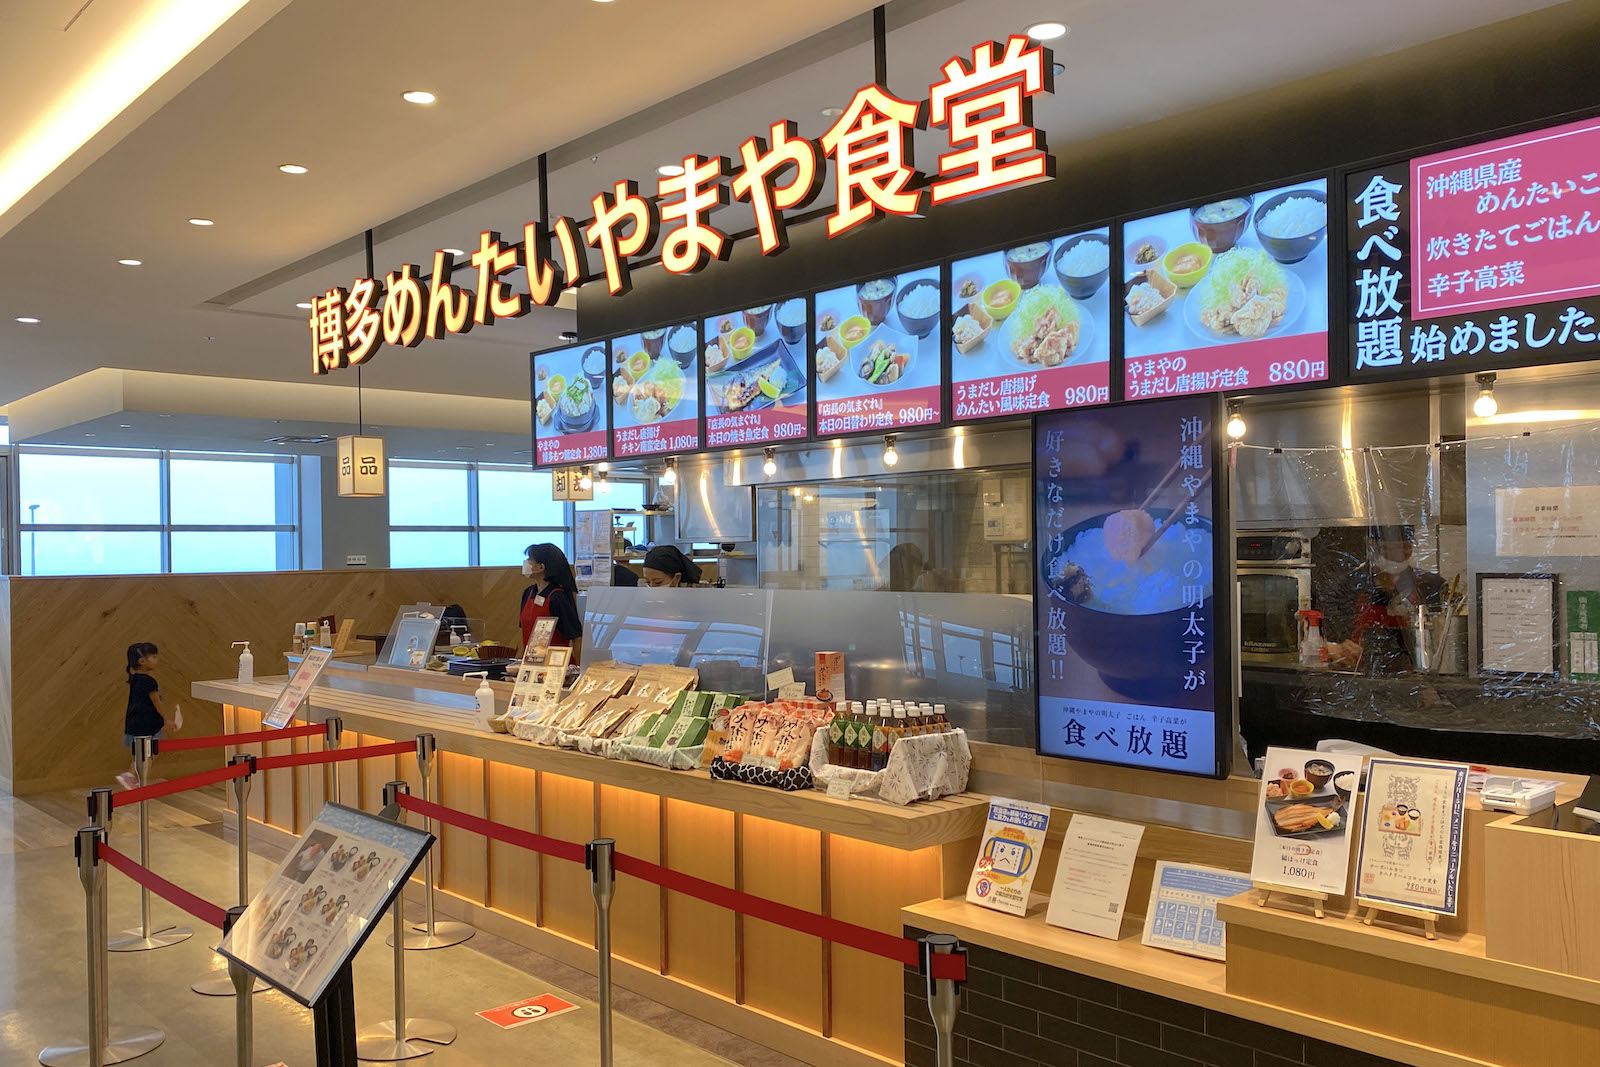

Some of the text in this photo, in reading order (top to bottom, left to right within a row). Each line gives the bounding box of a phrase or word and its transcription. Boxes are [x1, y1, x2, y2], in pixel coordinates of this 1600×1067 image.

[1425, 158, 1522, 200] 沖縄県産
[308, 35, 1048, 375] 博多めんたいやまや食堂
[1426, 211, 1600, 262] 炊きたてごはん
[1354, 174, 1404, 370] 食べ放題
[1427, 260, 1525, 298] 辛子高菜
[1410, 306, 1600, 364] 始めました
[957, 374, 1037, 398] うまだし唐揚げ
[1127, 356, 1187, 378] やまやの
[1129, 359, 1325, 397] うまだし唐揚げ定食 880円
[956, 385, 1108, 417] めんたい風味定食 980円
[708, 428, 769, 445] 本日の焼き魚定食
[818, 411, 893, 433] 本日の日替わり定食
[1179, 415, 1206, 691] 沖縄やまやの明太子が
[1063, 718, 1188, 759] 食べ放題
